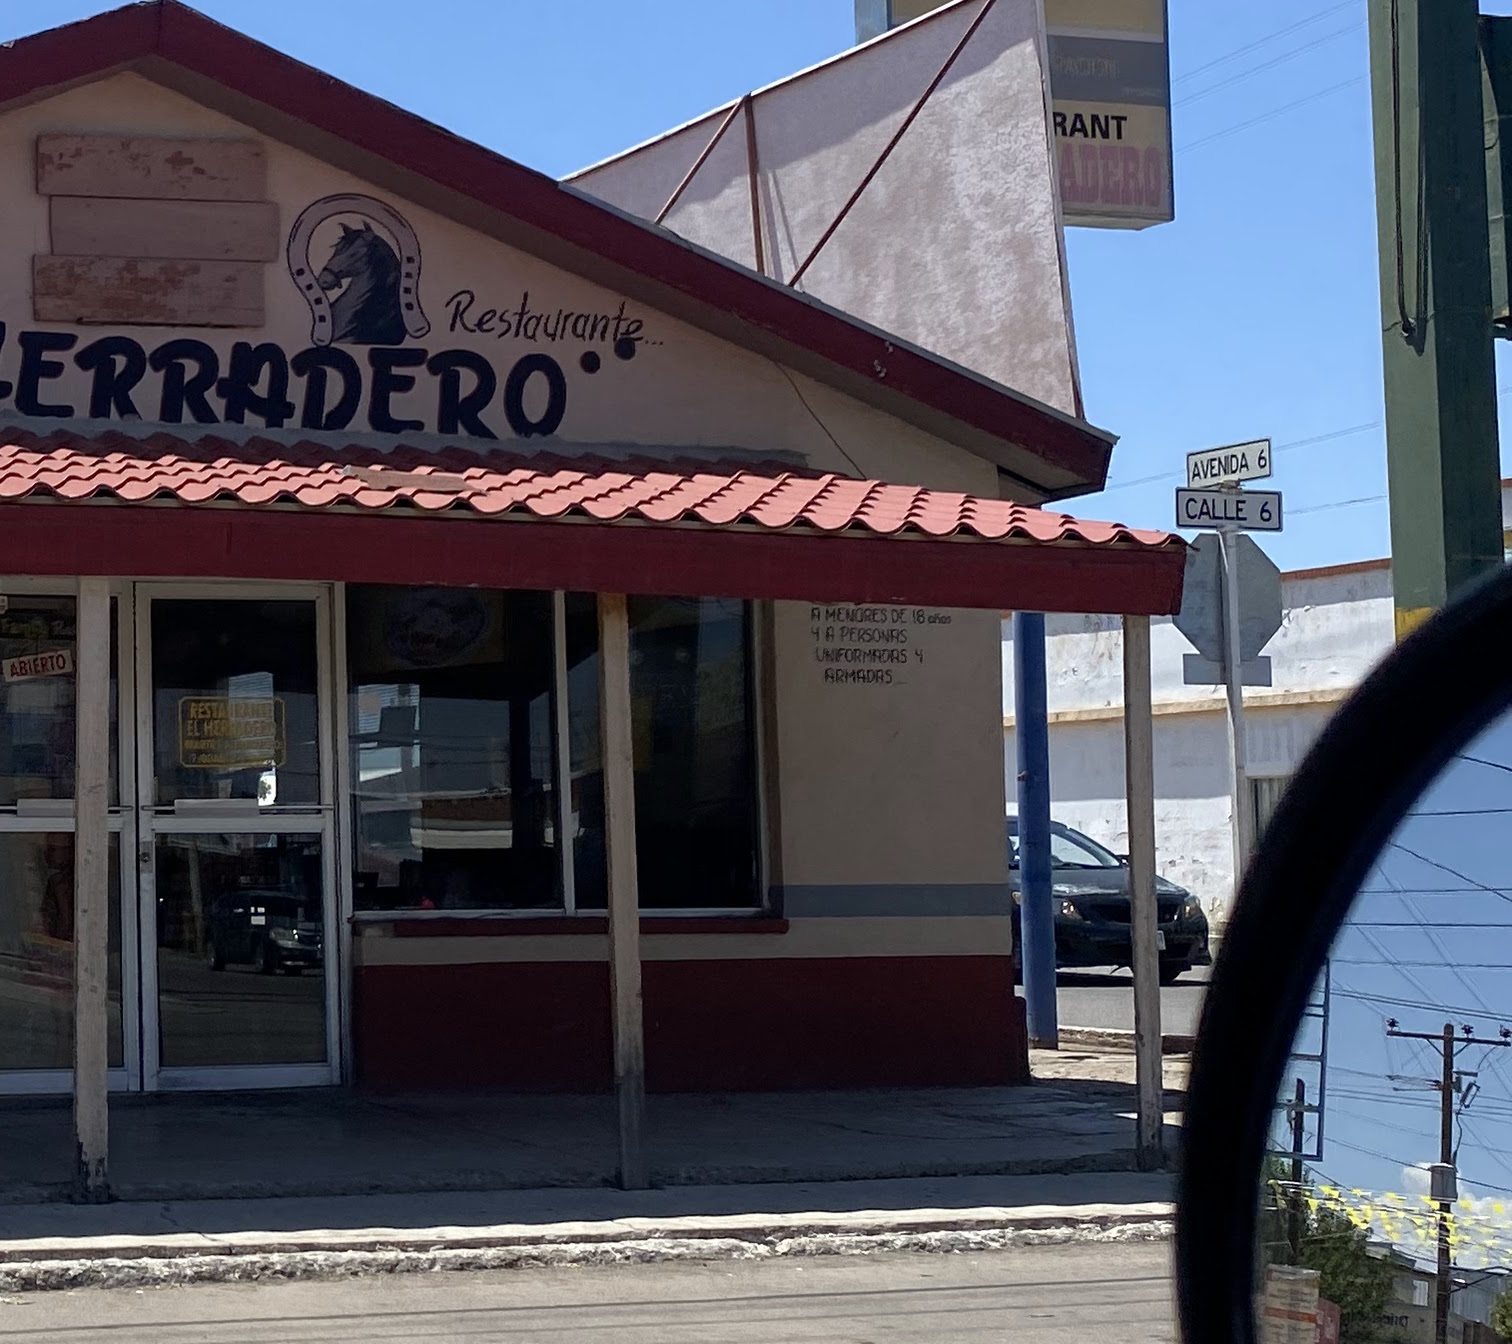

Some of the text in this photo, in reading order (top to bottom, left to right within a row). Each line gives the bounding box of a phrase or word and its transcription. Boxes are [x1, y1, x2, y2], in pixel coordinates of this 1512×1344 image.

[1191, 448, 1268, 483] AVENIDA 6
[1185, 497, 1273, 523] CALLE 6
[810, 607, 821, 622] A
[825, 607, 888, 623] MENORES
[891, 608, 908, 624] DE
[912, 609, 925, 625] 18
[825, 626, 835, 643] A
[839, 626, 908, 644] PERSONAS
[815, 647, 908, 664] UNIFORMADAS
[10, 654, 66, 678] ABIERTO
[824, 667, 893, 685] ARMADAS
